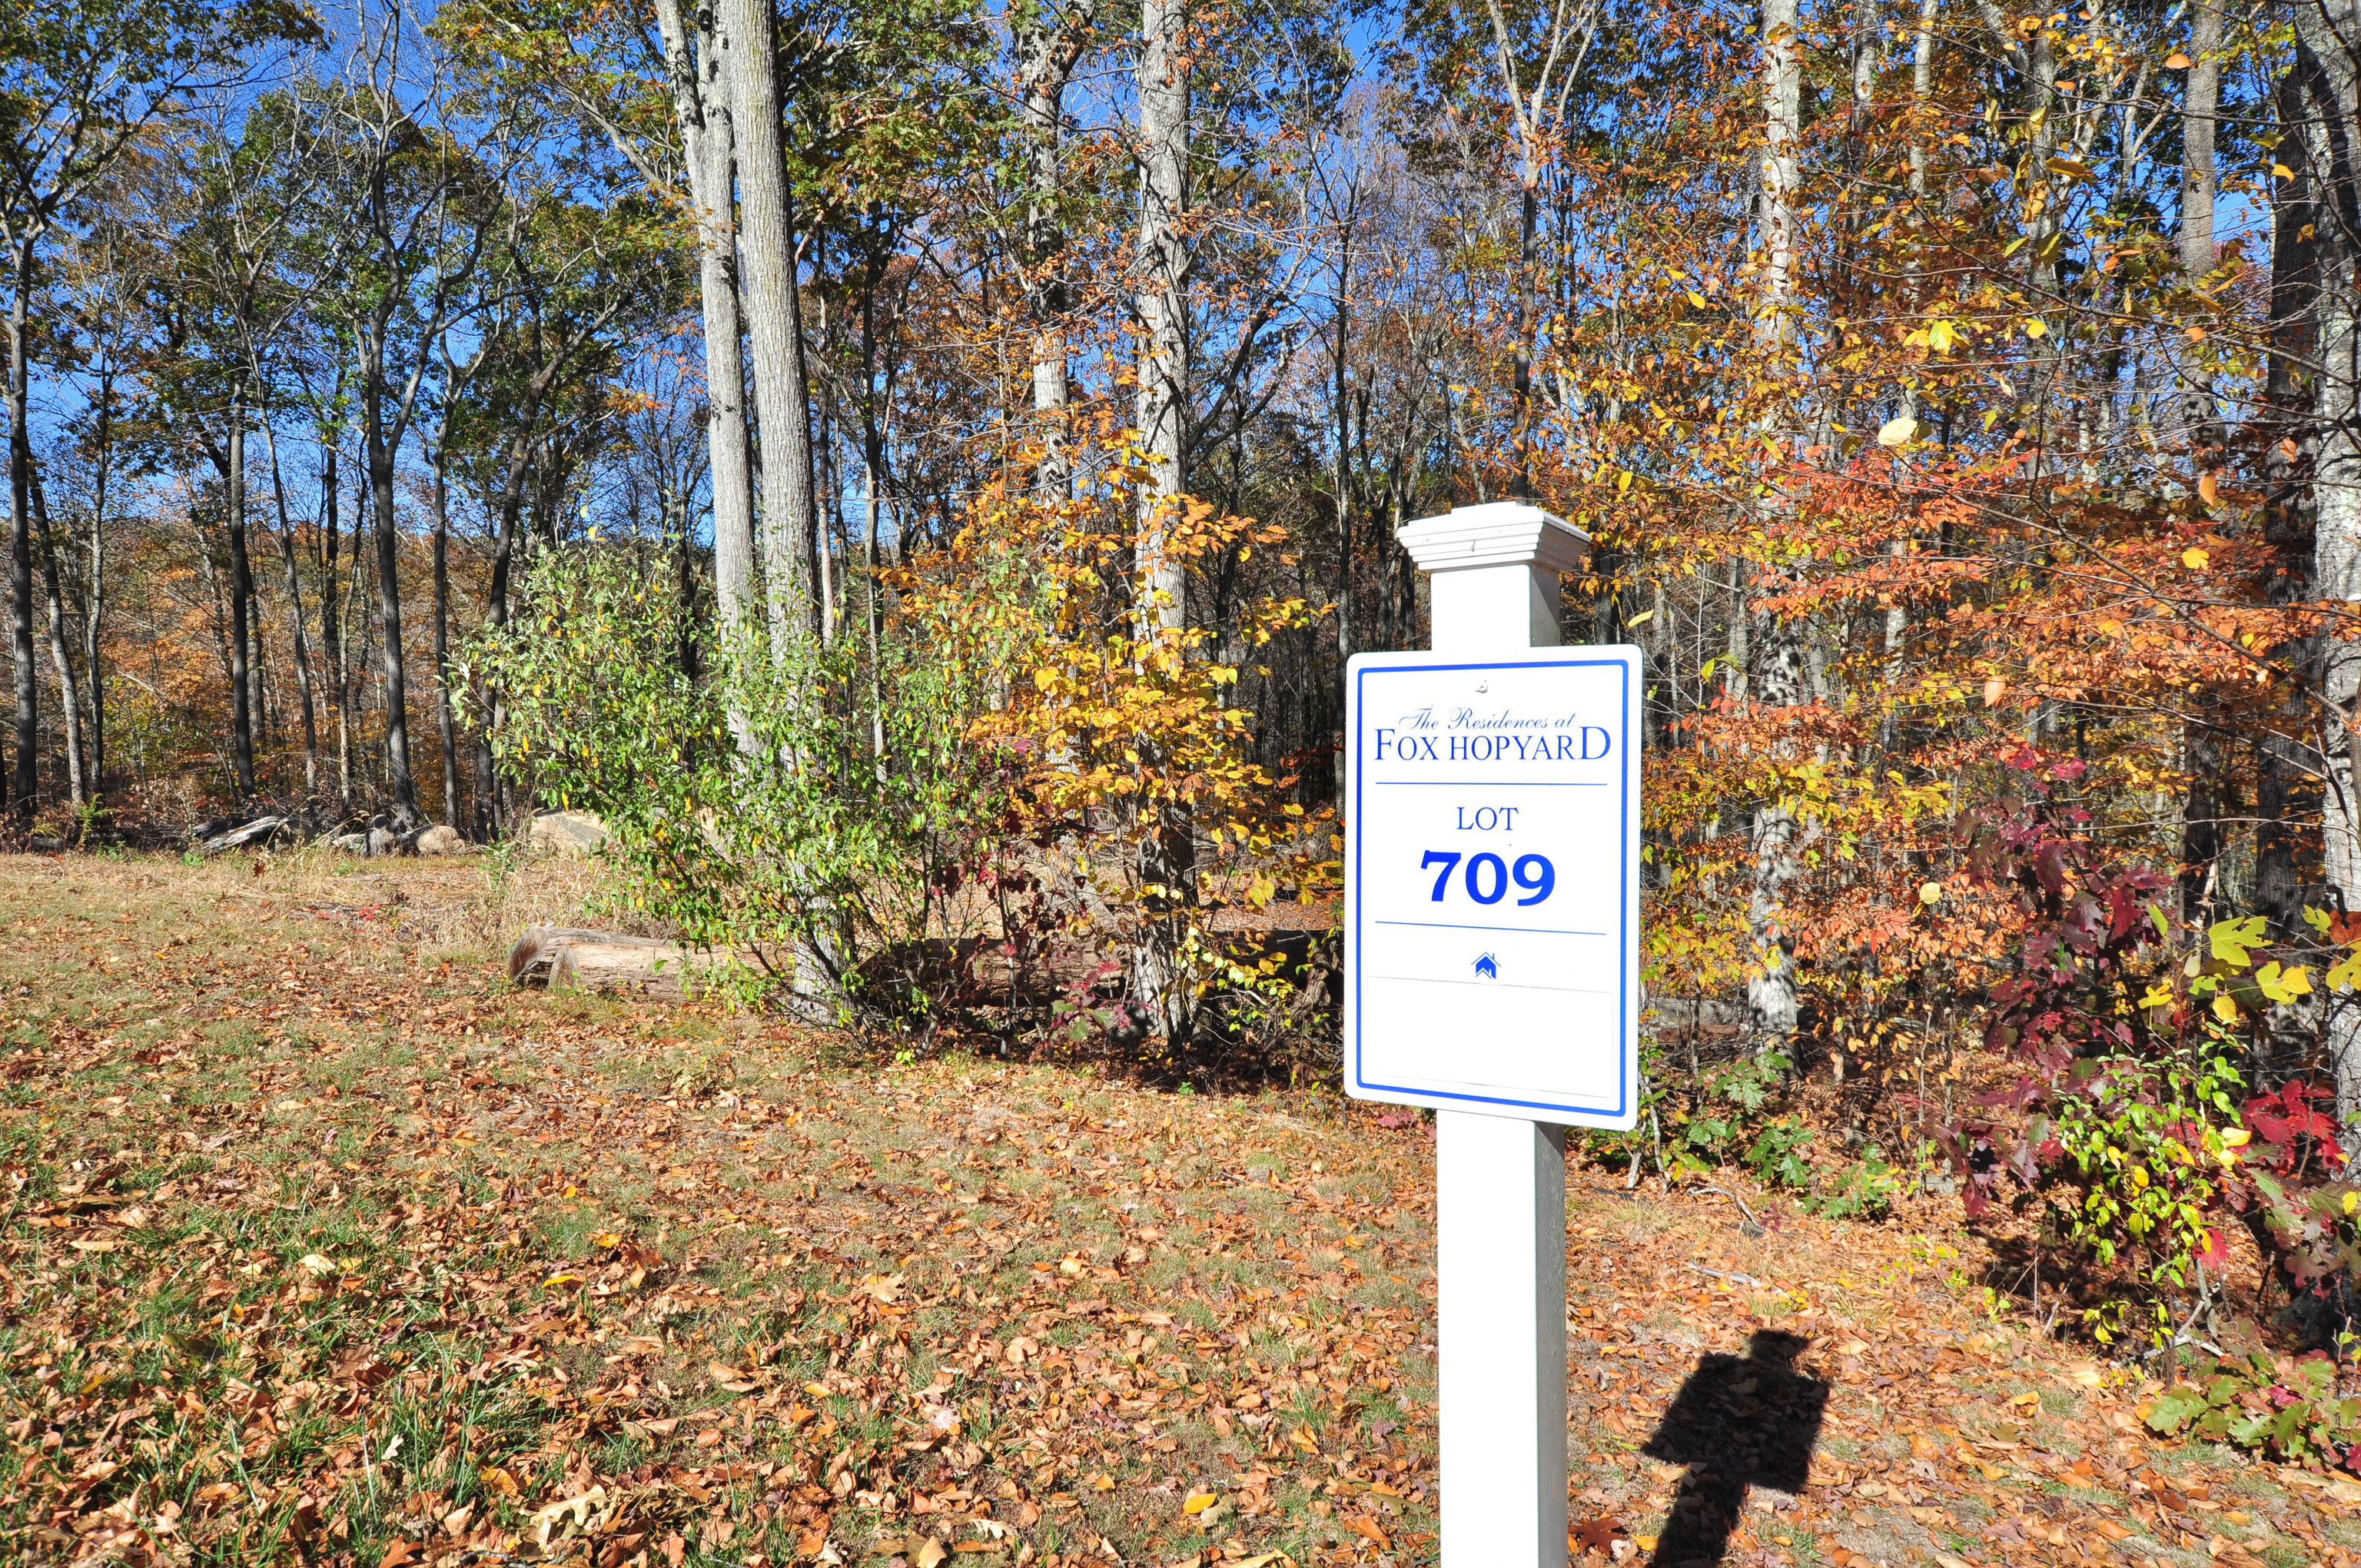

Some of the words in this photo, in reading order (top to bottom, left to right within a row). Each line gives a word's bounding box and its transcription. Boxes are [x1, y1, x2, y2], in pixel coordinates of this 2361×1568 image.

[1399, 706, 1439, 729] The
[1448, 707, 1548, 729] Residences
[1555, 713, 1576, 729] at
[1374, 729, 1440, 761] FOX
[1449, 726, 1611, 760] HOPYARD
[1456, 806, 1519, 831] LOT
[1420, 849, 1556, 906] 709
